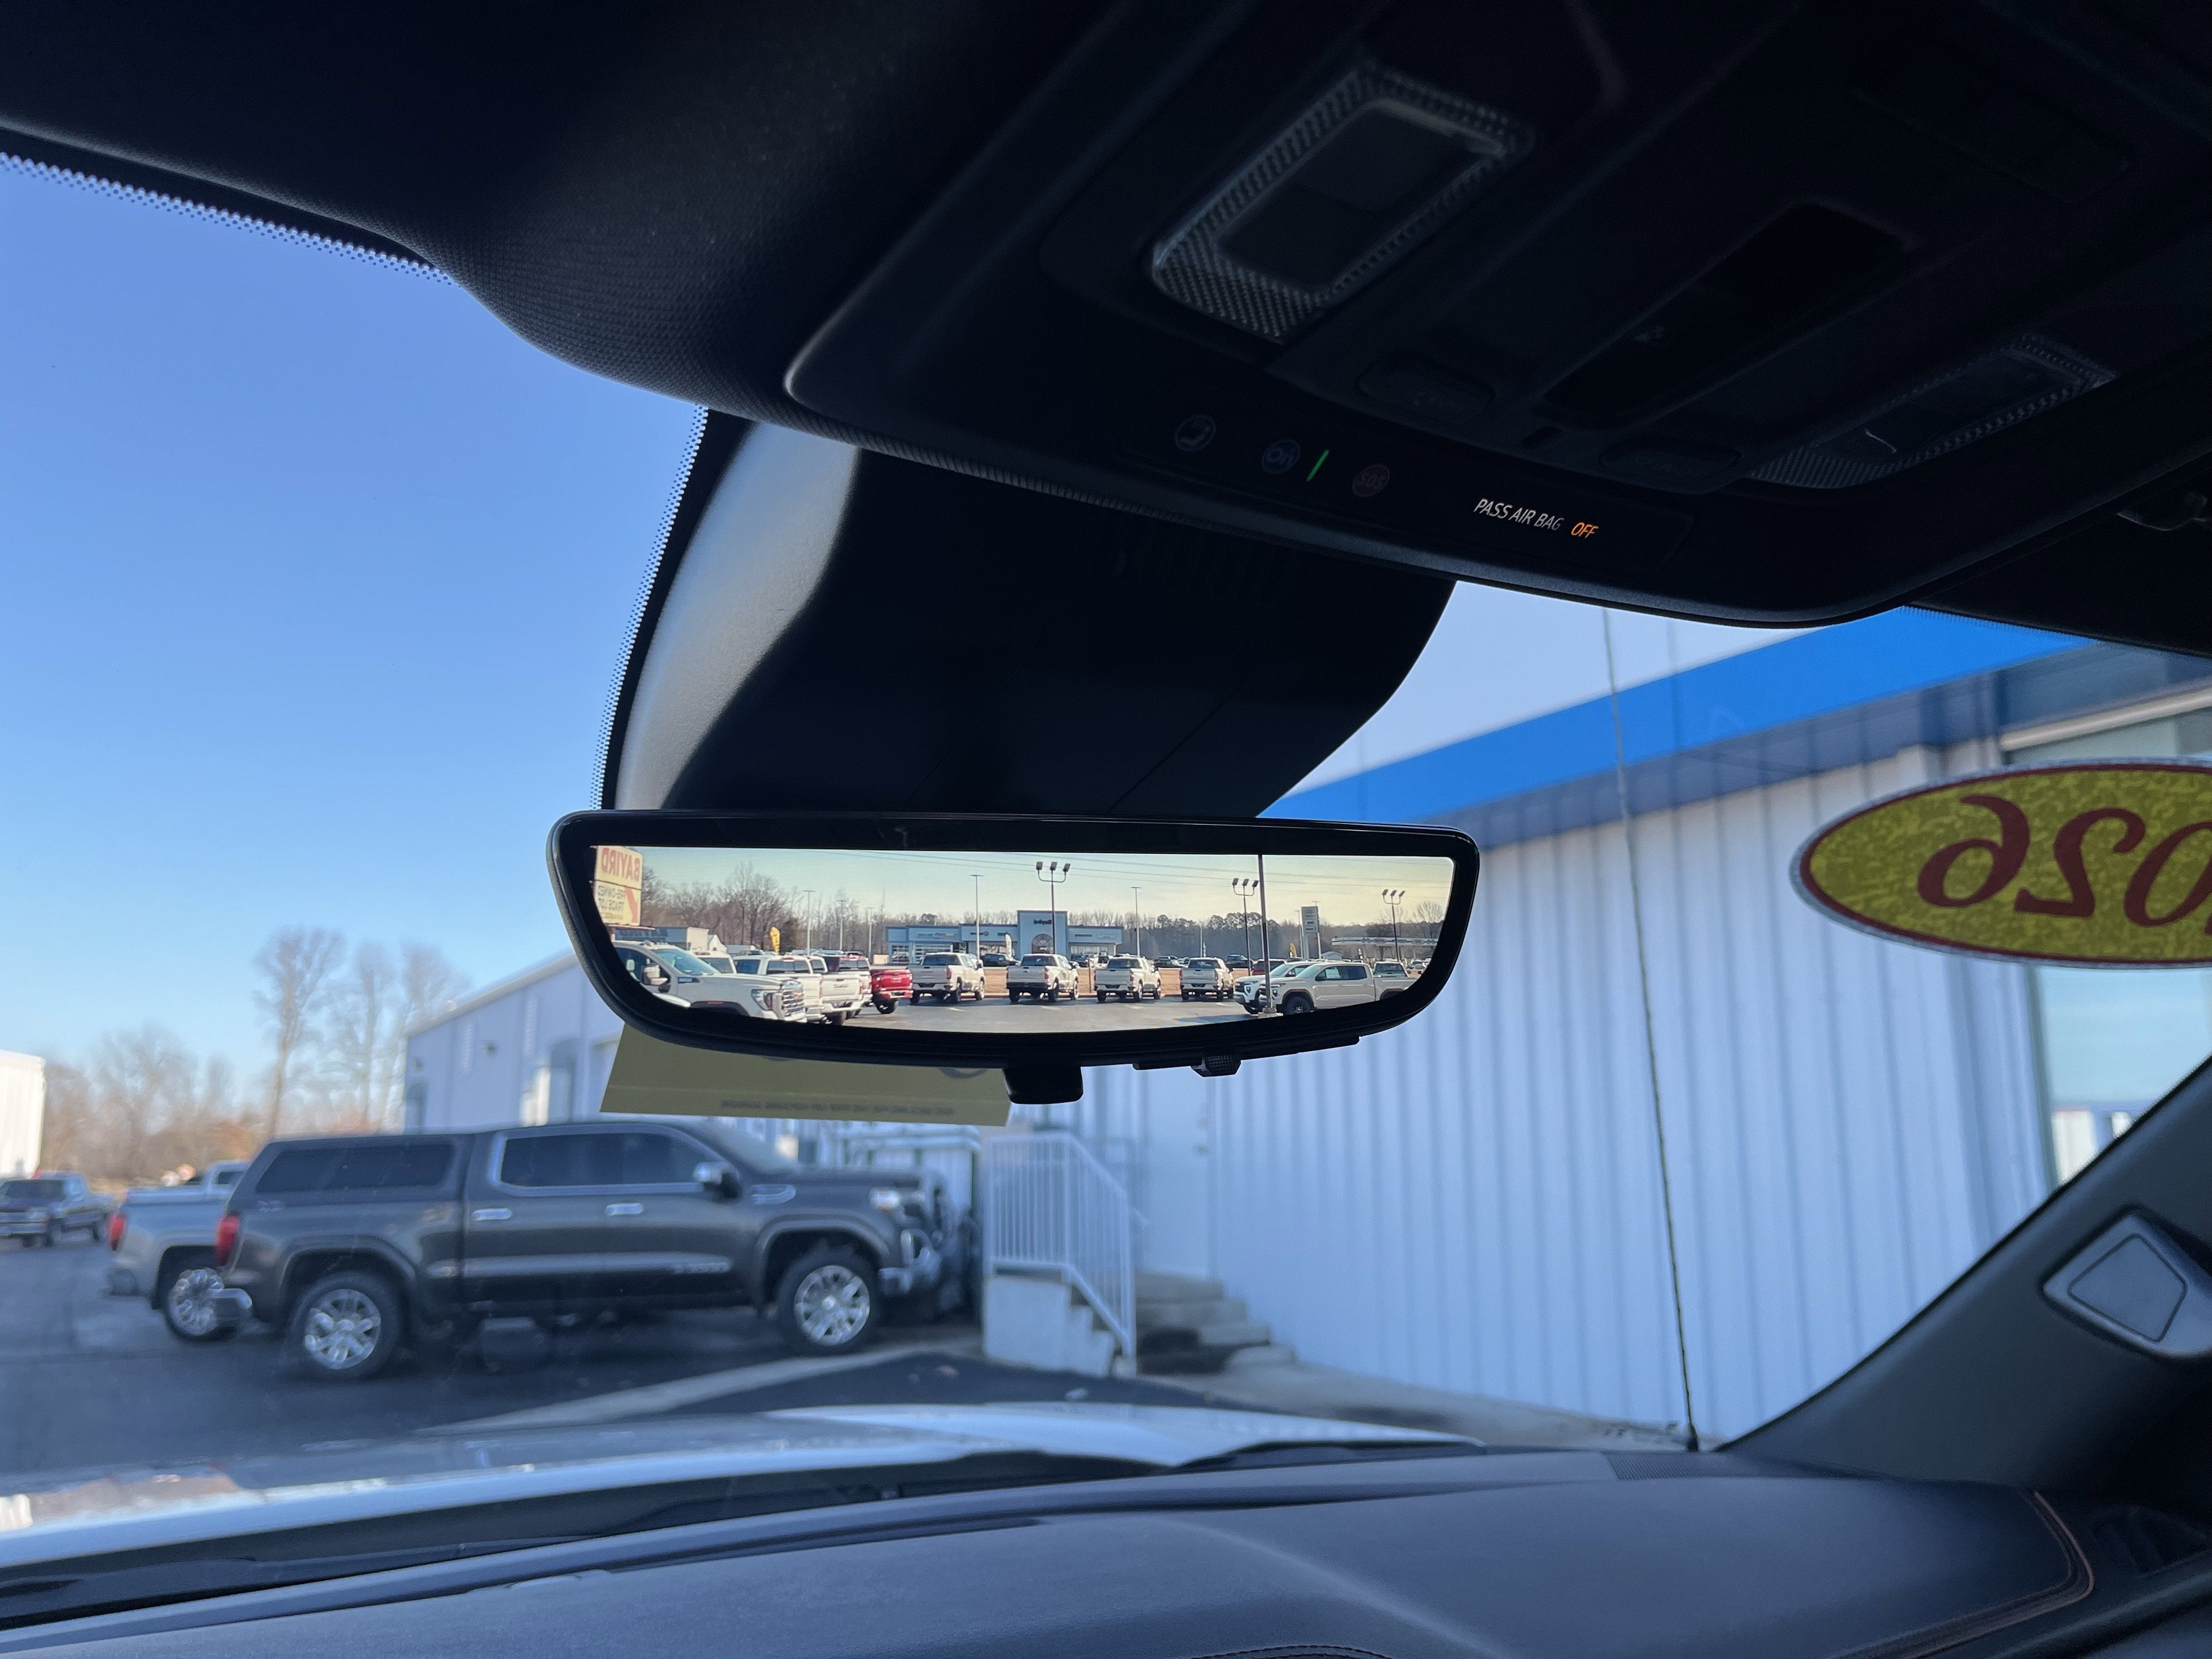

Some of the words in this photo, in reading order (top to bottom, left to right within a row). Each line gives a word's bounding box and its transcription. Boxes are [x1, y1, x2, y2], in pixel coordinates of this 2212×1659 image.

[1356, 472, 1386, 489] SOS
[1473, 498, 1513, 519] PASS
[1509, 507, 1536, 525] AIR
[1534, 514, 1565, 531] BAG
[1571, 522, 1599, 539] OFF
